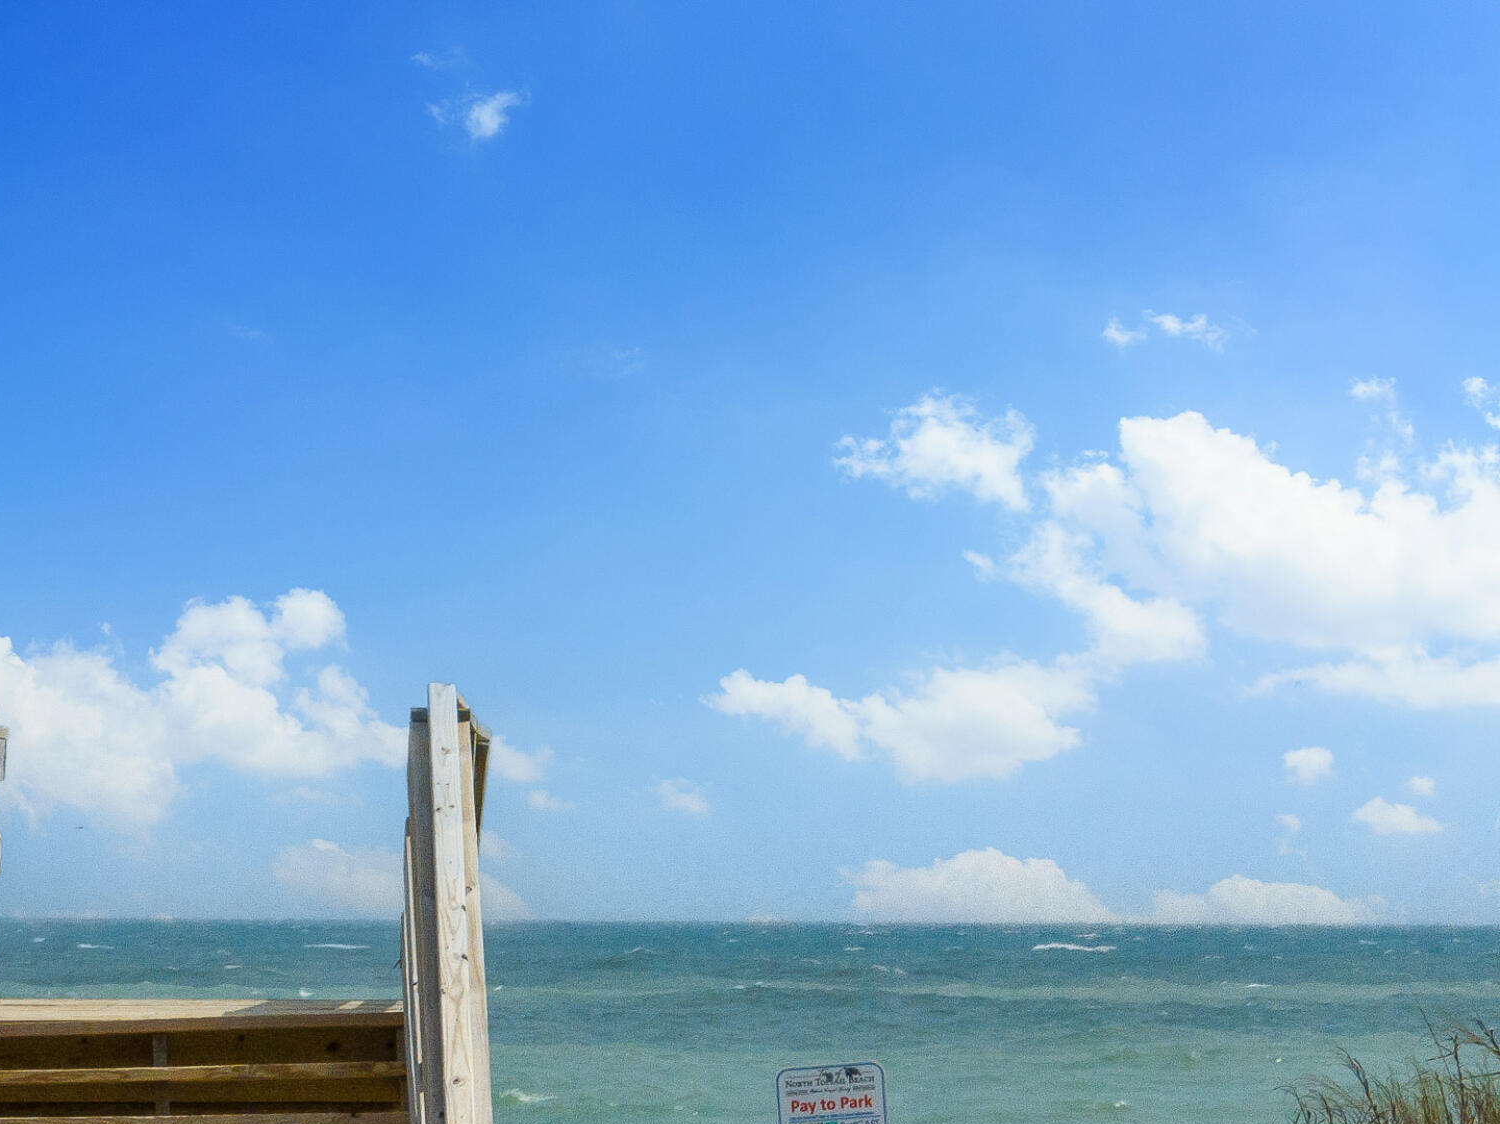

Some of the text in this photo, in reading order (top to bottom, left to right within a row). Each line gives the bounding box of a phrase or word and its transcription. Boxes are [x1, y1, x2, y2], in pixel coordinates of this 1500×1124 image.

[791, 1094, 873, 1114] Pay to Park
